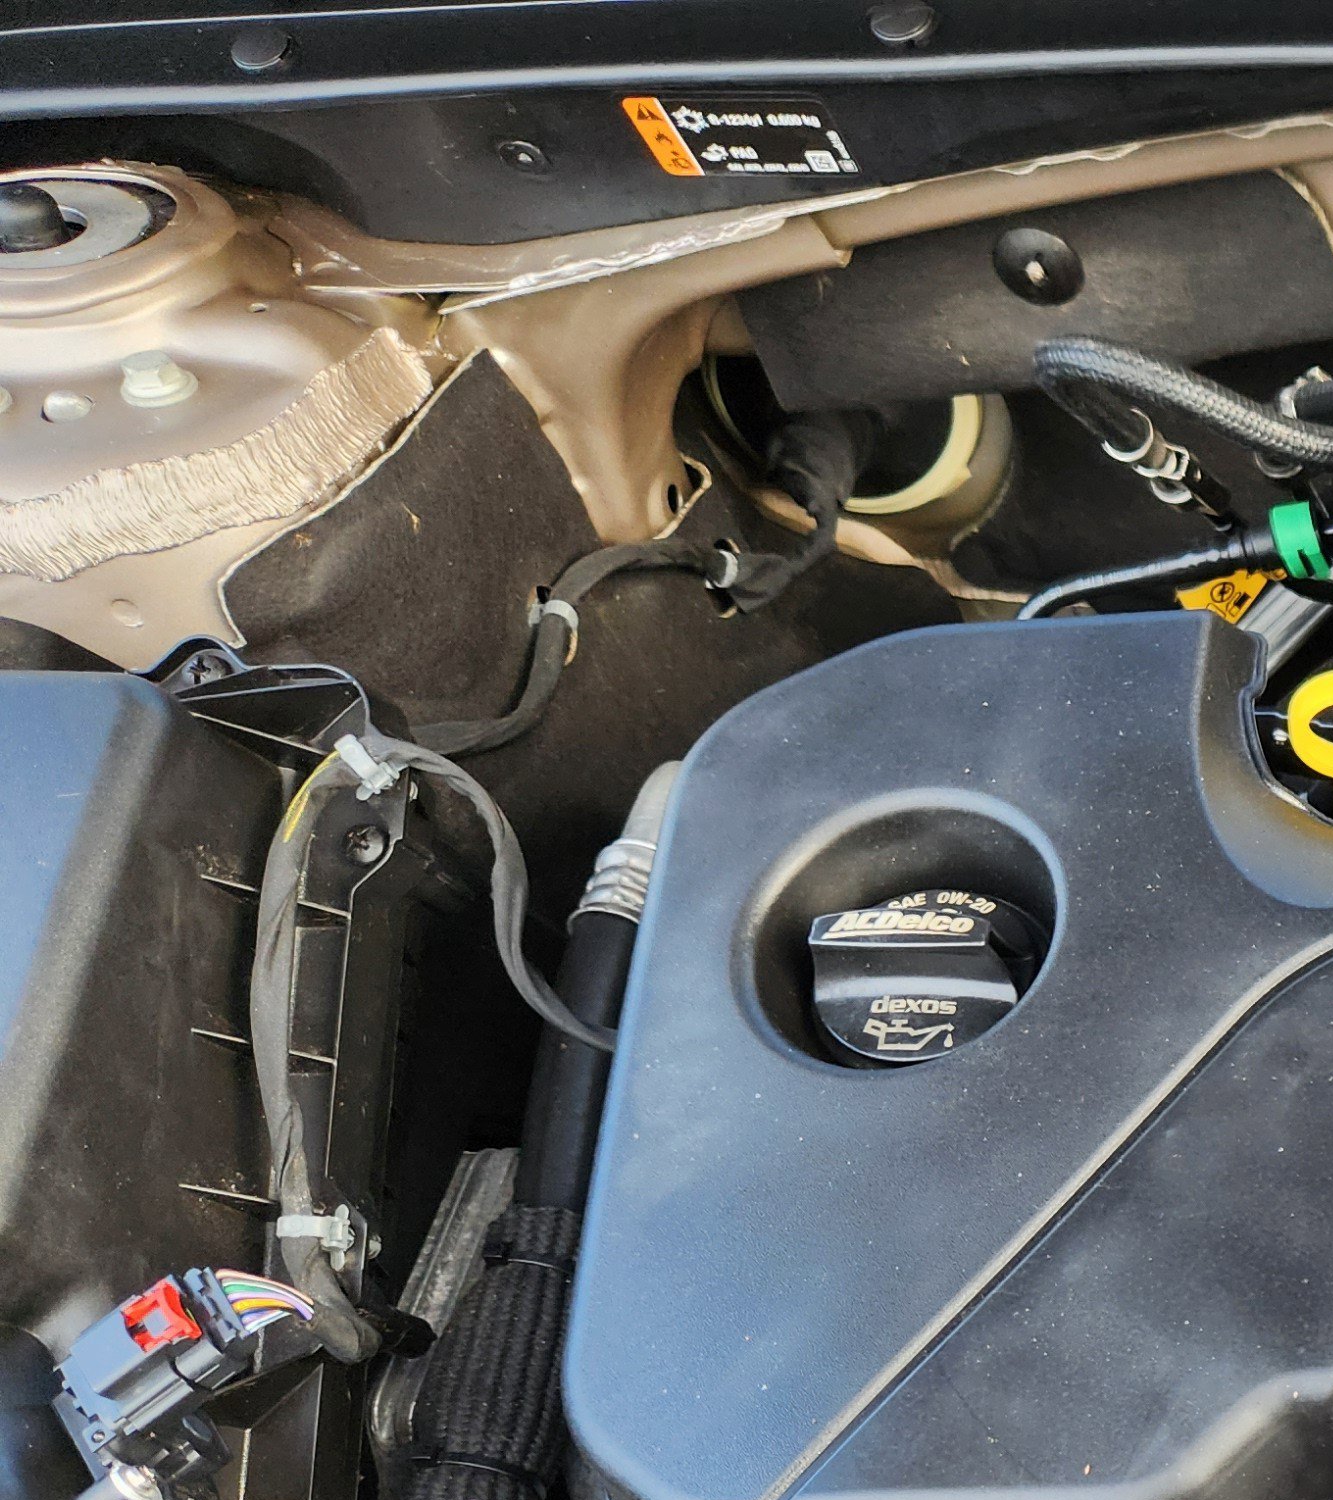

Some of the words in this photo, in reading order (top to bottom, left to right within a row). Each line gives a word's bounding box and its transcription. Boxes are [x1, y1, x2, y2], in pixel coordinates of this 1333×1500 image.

[888, 893, 927, 909] SAE
[936, 891, 996, 914] 0W-20
[828, 911, 975, 933] ACDelco
[870, 995, 957, 1015] dexos
